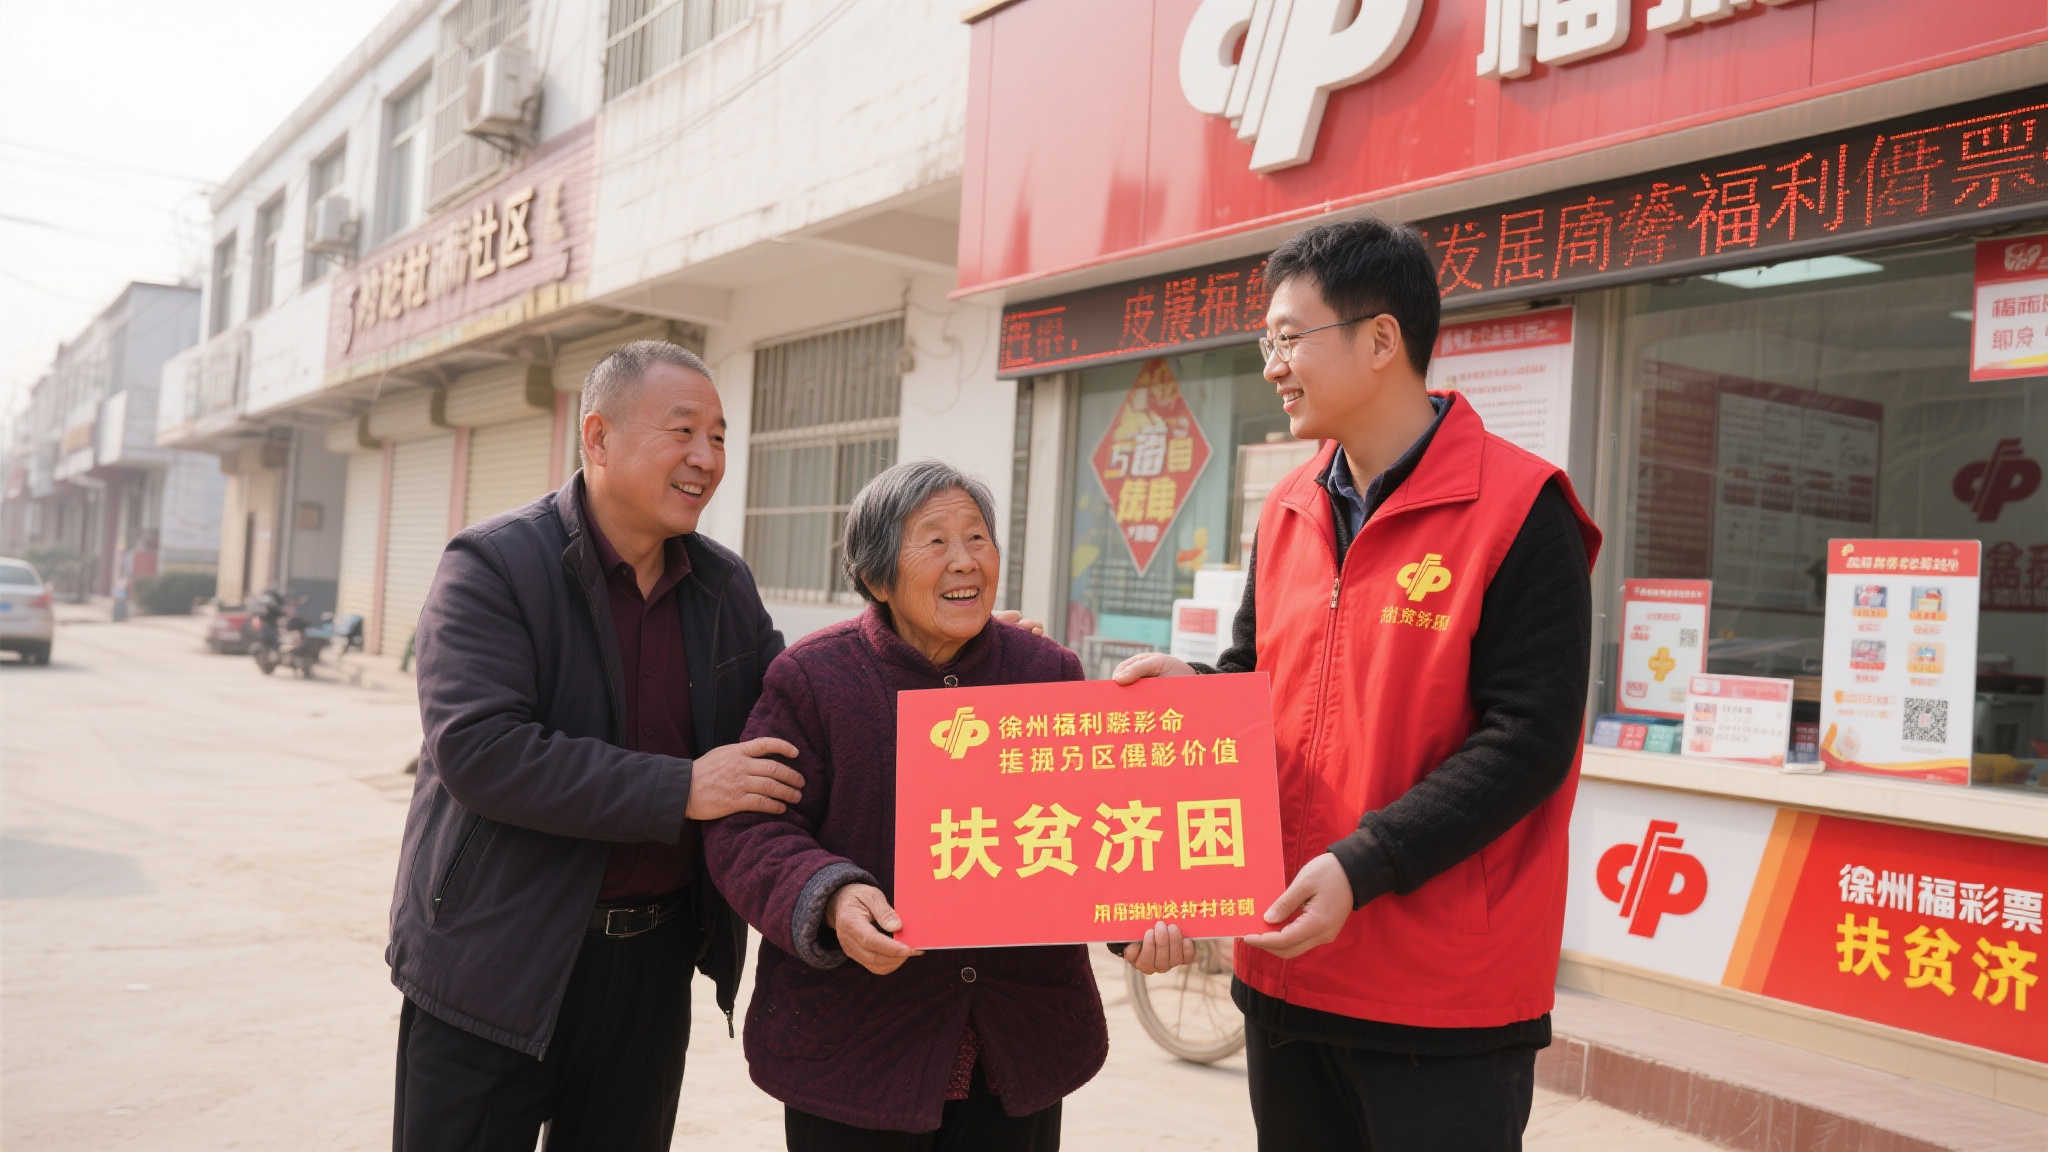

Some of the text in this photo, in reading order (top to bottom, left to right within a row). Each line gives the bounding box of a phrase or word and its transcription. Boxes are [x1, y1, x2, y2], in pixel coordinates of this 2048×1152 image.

[930, 798, 1246, 881] 扶贫济困
[1838, 863, 2044, 935] 徐州福彩票
[1836, 912, 2040, 1012] 扶贫济
